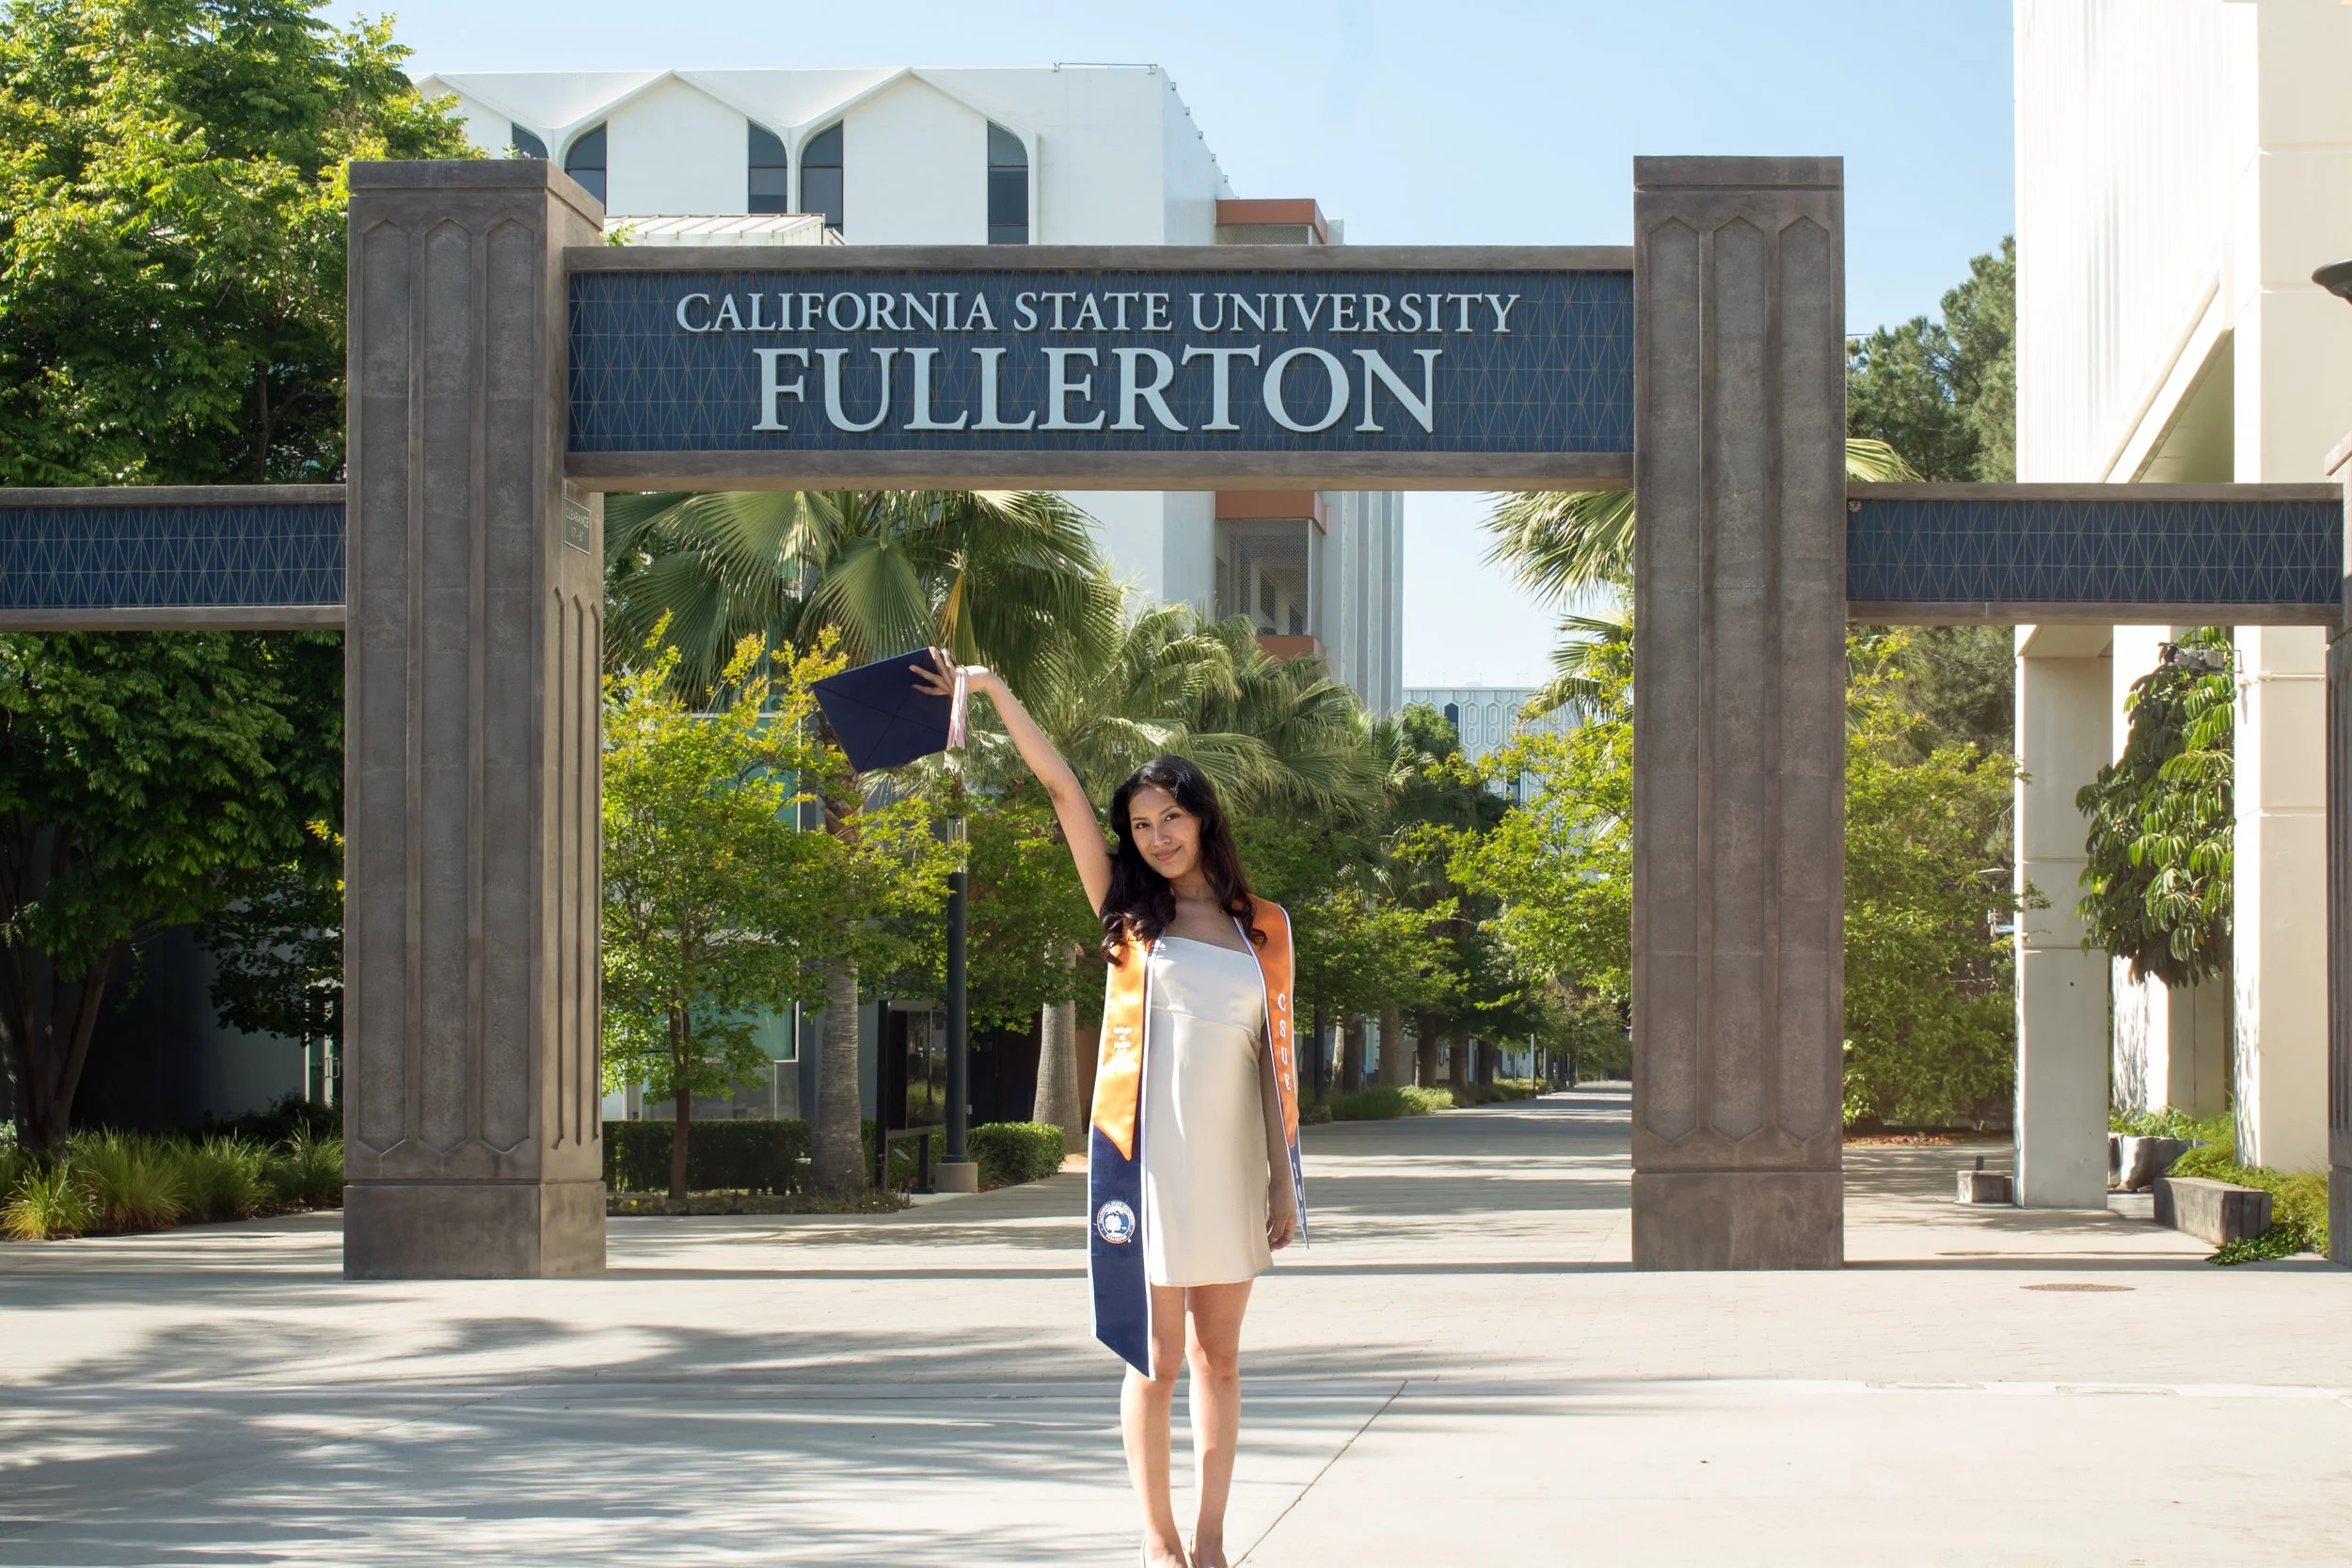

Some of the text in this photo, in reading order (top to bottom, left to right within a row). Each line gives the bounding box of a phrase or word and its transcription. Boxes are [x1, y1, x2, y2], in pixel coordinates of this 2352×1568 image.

[675, 291, 1520, 333] CALIFORNIA STATE UNIVERSITY
[752, 343, 1443, 434] FULLERTON
